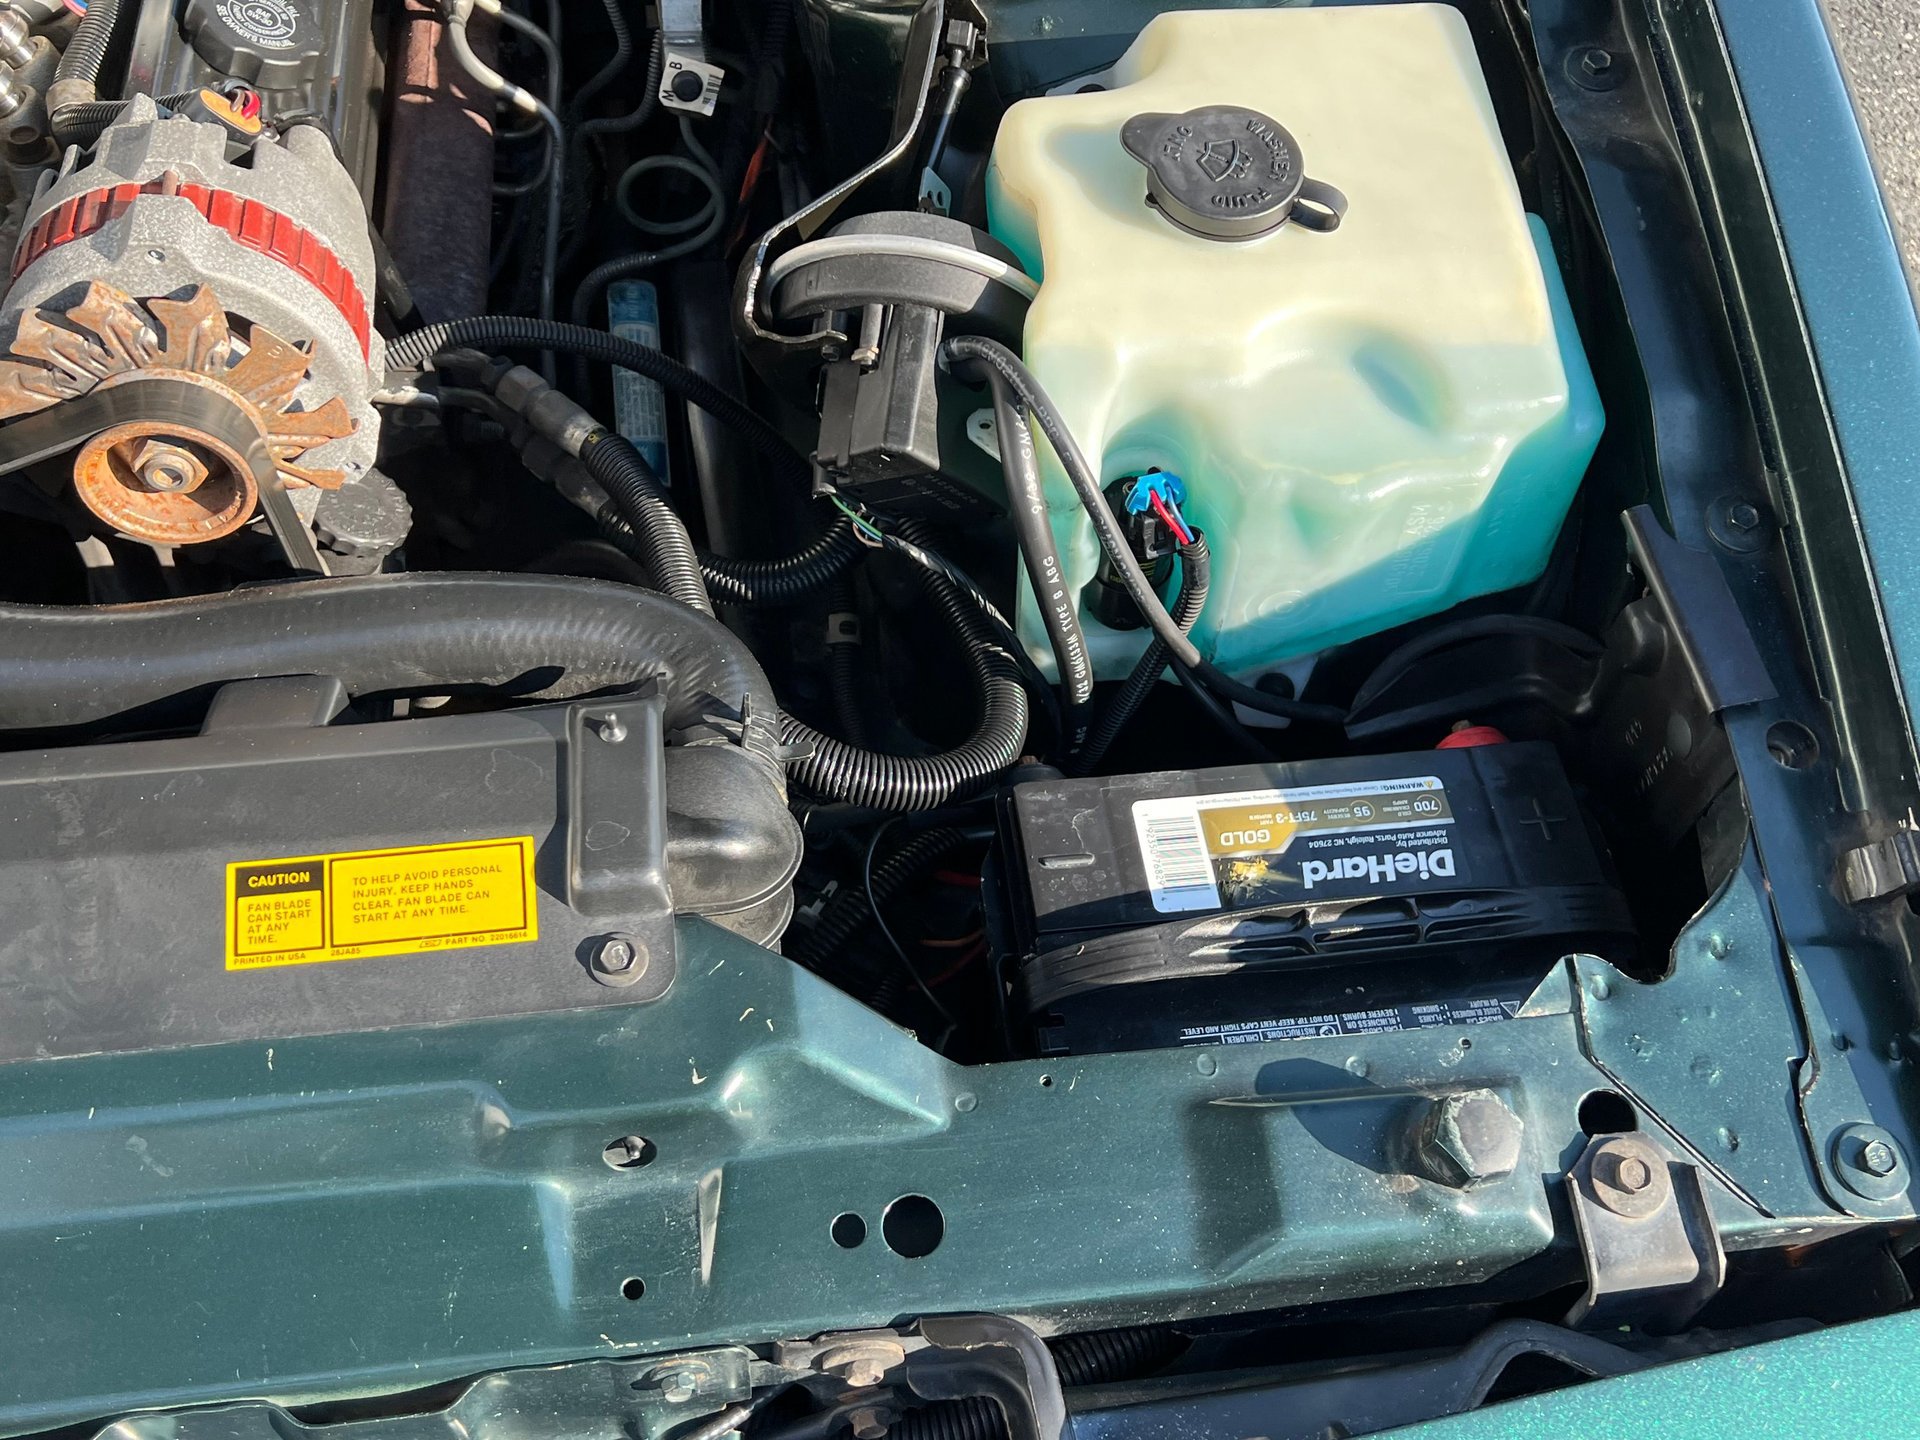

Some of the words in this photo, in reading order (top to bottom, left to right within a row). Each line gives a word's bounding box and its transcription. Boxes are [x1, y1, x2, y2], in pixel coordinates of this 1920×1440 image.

[1246, 119, 1290, 182] WASHER
[1211, 187, 1272, 208] FLUID
[1042, 555, 1060, 585] ABG
[1052, 589, 1064, 601] B
[1056, 603, 1073, 632] TYPE
[1353, 805, 1371, 817] 95
[1413, 799, 1438, 812] 700
[1275, 810, 1318, 823] 75FT-3
[1220, 828, 1271, 846] GOLD
[1375, 833, 1396, 842] Parts,
[1397, 832, 1415, 840] Auto
[1416, 829, 1447, 839] Advance
[1333, 838, 1344, 846] NC
[1408, 836, 1448, 848] Distributed
[248, 871, 310, 888] CAUTION
[353, 876, 369, 886] TO
[371, 873, 401, 886] HELP
[405, 870, 440, 882] AVOID
[443, 864, 503, 878] PERSONAL
[353, 887, 398, 899] INJURY.
[401, 882, 431, 894] KEEP
[434, 879, 474, 891] HANDS
[247, 901, 272, 913] FAN
[275, 898, 311, 911] BLADE
[353, 899, 394, 911] CLEAR.
[397, 896, 422, 907] FAN
[425, 893, 462, 905] BLADE
[464, 890, 491, 901] CAN
[247, 911, 273, 923] CAN
[275, 908, 312, 920] START
[353, 912, 392, 924] START
[393, 909, 410, 920] AT
[412, 907, 437, 918] ANY
[440, 904, 469, 916] TIME.
[247, 923, 265, 934] AT
[266, 921, 290, 933] ANY
[247, 934, 278, 945] TIME.
[445, 937, 468, 946] PART
[234, 954, 272, 966] PRINTED
[275, 953, 287, 963] IN
[288, 952, 306, 961] USA
[1309, 1015, 1322, 1023] NOT
[1323, 1014, 1334, 1022] DO
[1367, 1008, 1394, 1018] SEVERE
[1219, 1023, 1240, 1032] TIGHT
[1240, 1021, 1260, 1030] CAPS
[1259, 1020, 1278, 1028] VENT
[1277, 1018, 1295, 1027] KEEP
[1346, 1020, 1356, 1028] OR
[1358, 1017, 1397, 1027] BLINDNESS
[1180, 1027, 1204, 1036] LEVEL.
[1205, 1025, 1219, 1034] AND
